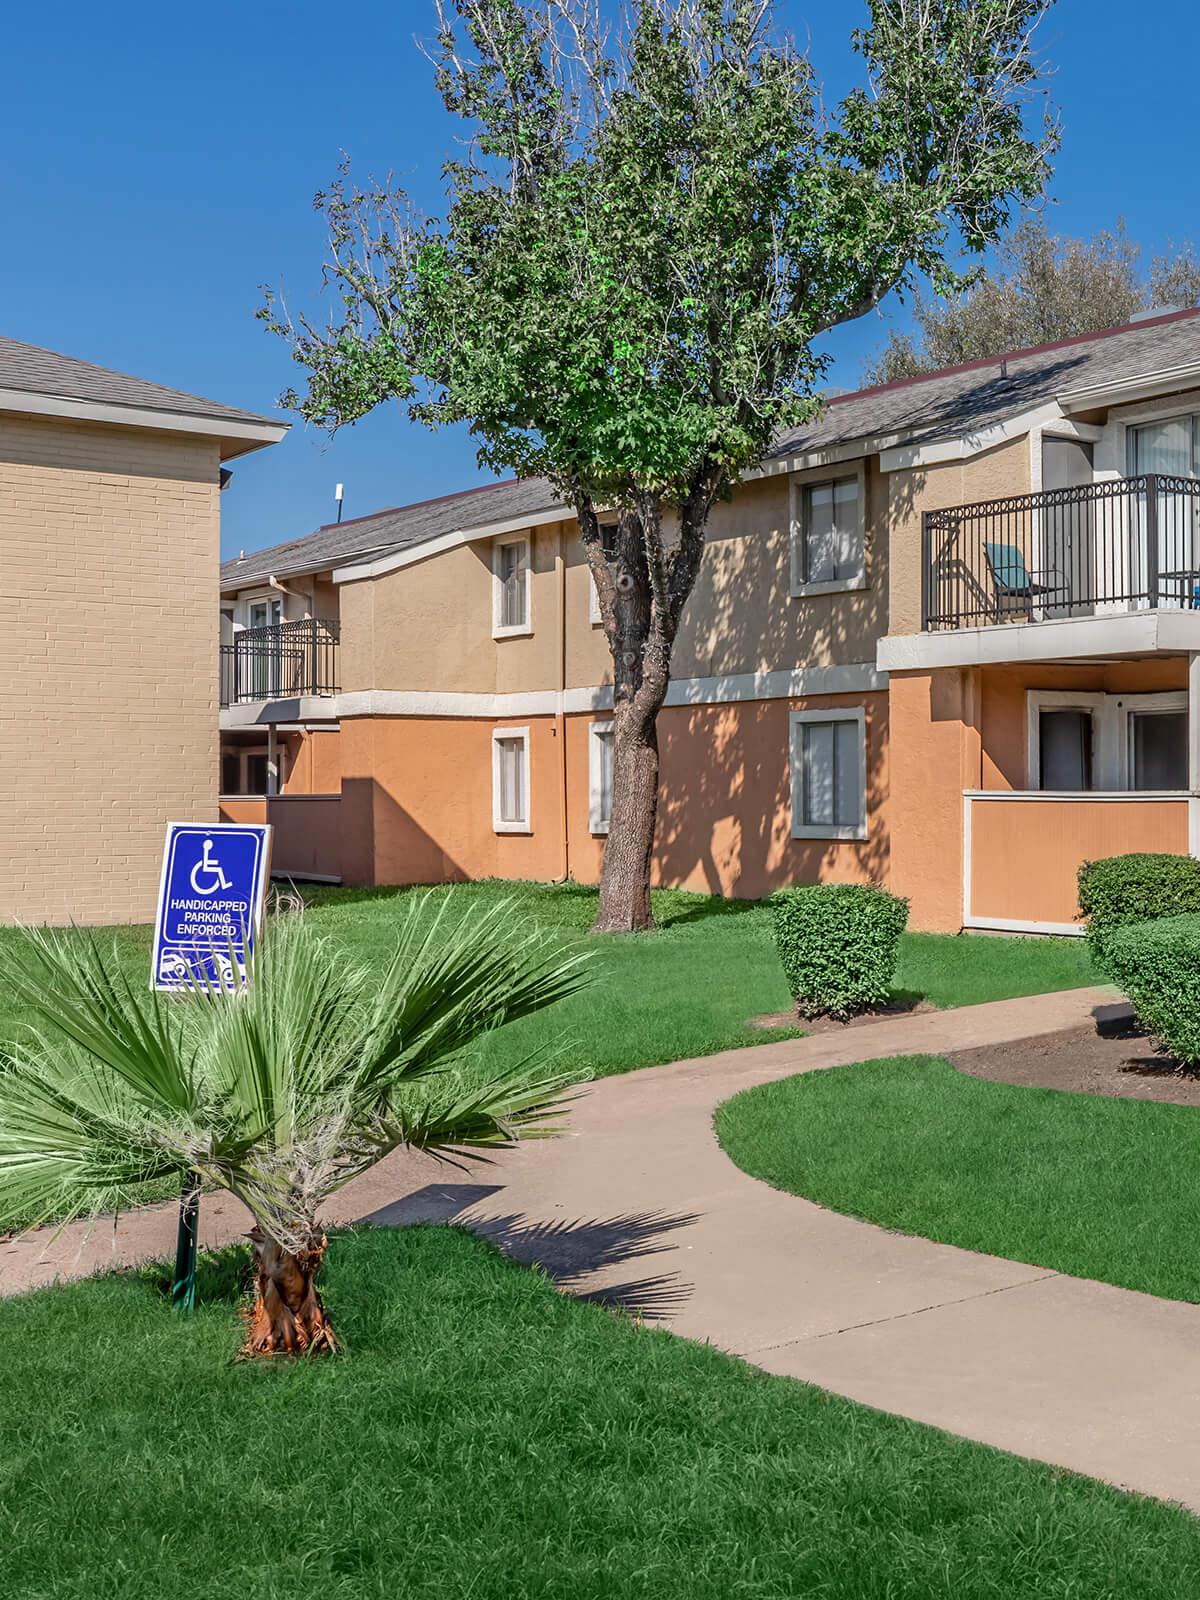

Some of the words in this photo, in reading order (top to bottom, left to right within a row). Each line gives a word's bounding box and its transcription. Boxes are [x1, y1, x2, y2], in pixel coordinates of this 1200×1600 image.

[171, 899, 247, 912] HANDICAPPED
[184, 912, 231, 923] PARKING
[177, 924, 236, 936] ENFORCED
